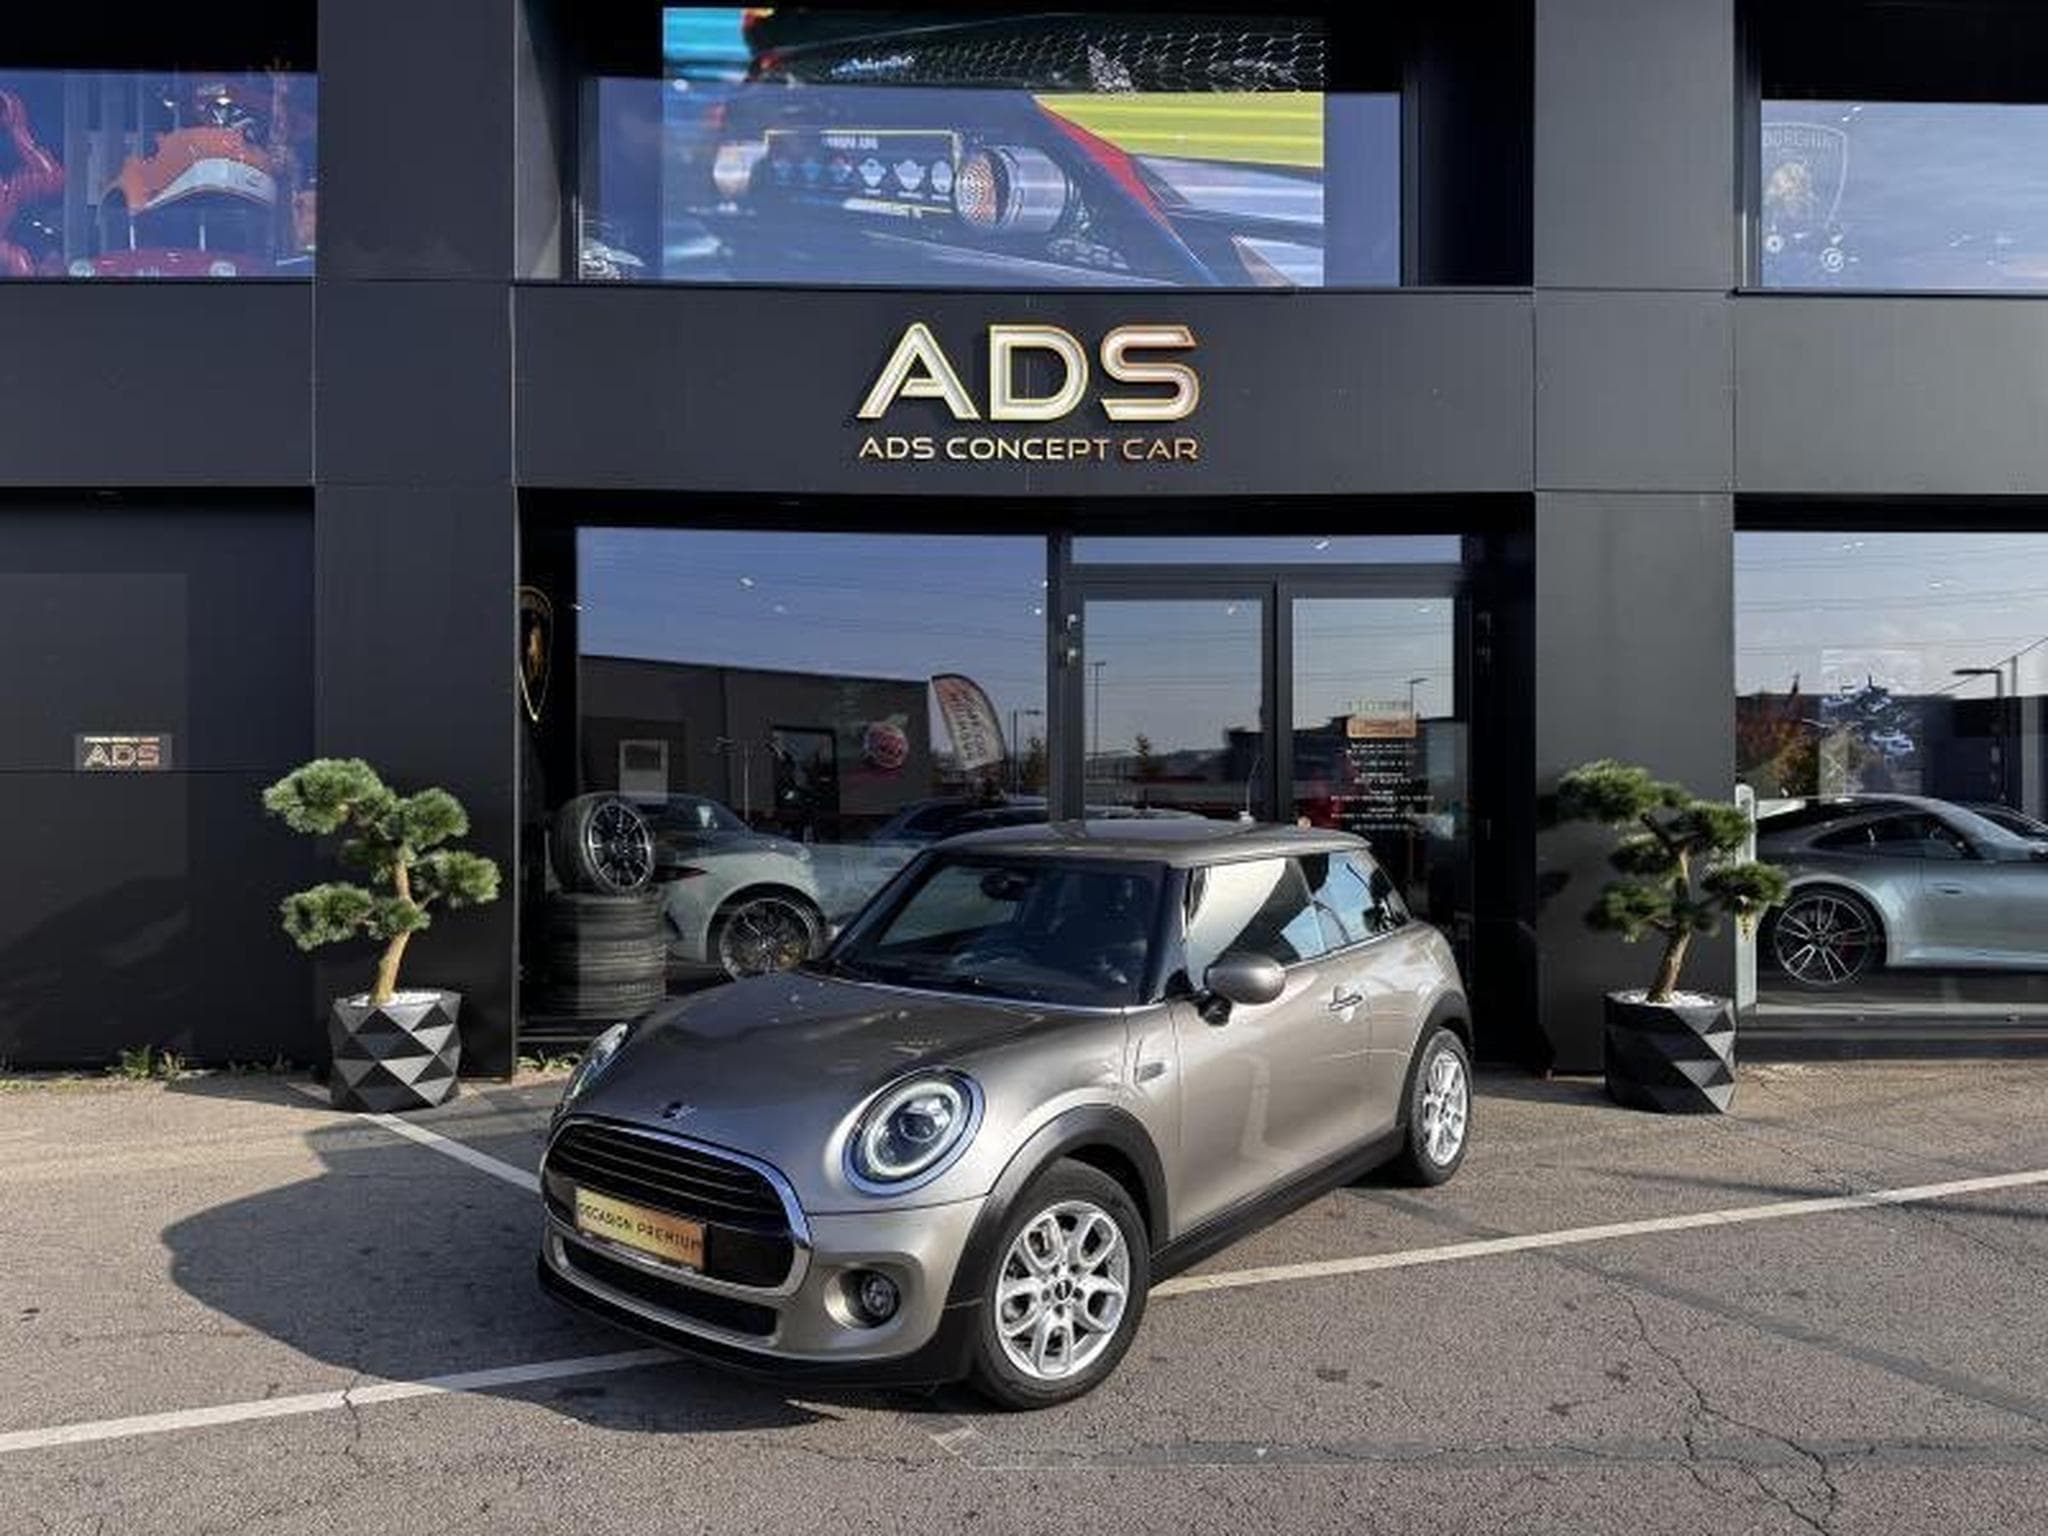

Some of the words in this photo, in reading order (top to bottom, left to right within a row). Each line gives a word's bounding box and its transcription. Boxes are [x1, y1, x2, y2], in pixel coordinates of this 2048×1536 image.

[857, 322, 1199, 421] ADS
[859, 437, 935, 460] ADS
[946, 437, 1110, 460] CONCEPT
[1122, 438, 1198, 460] CAR
[84, 744, 160, 767] ADS
[637, 1221, 701, 1250] PREMIUM
